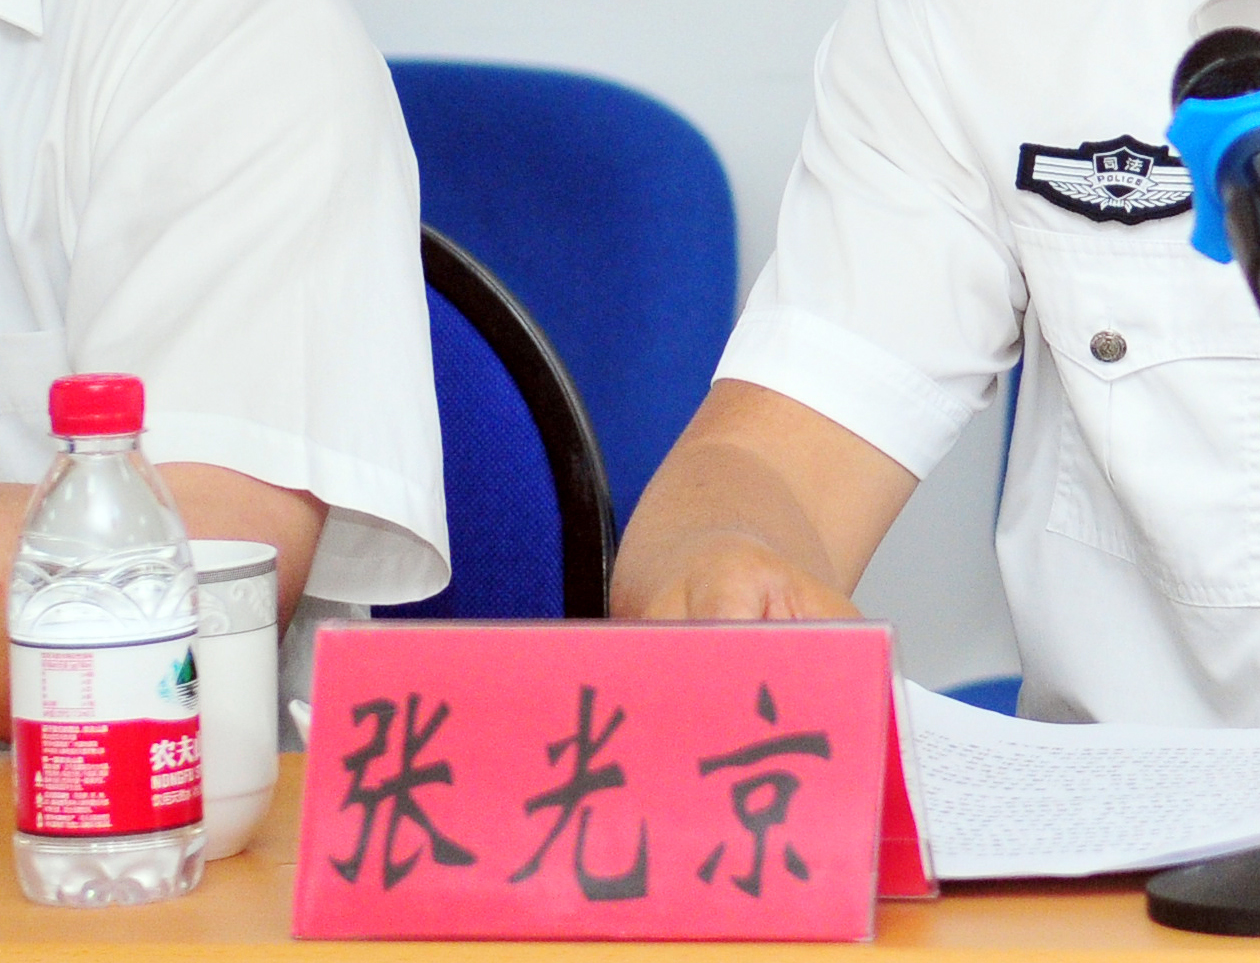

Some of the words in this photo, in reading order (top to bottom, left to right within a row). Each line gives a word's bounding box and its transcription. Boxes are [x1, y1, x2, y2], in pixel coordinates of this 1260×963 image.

[1103, 156, 1143, 172] 司法
[1097, 174, 1143, 186] POLICE
[329, 682, 832, 900] 张光京
